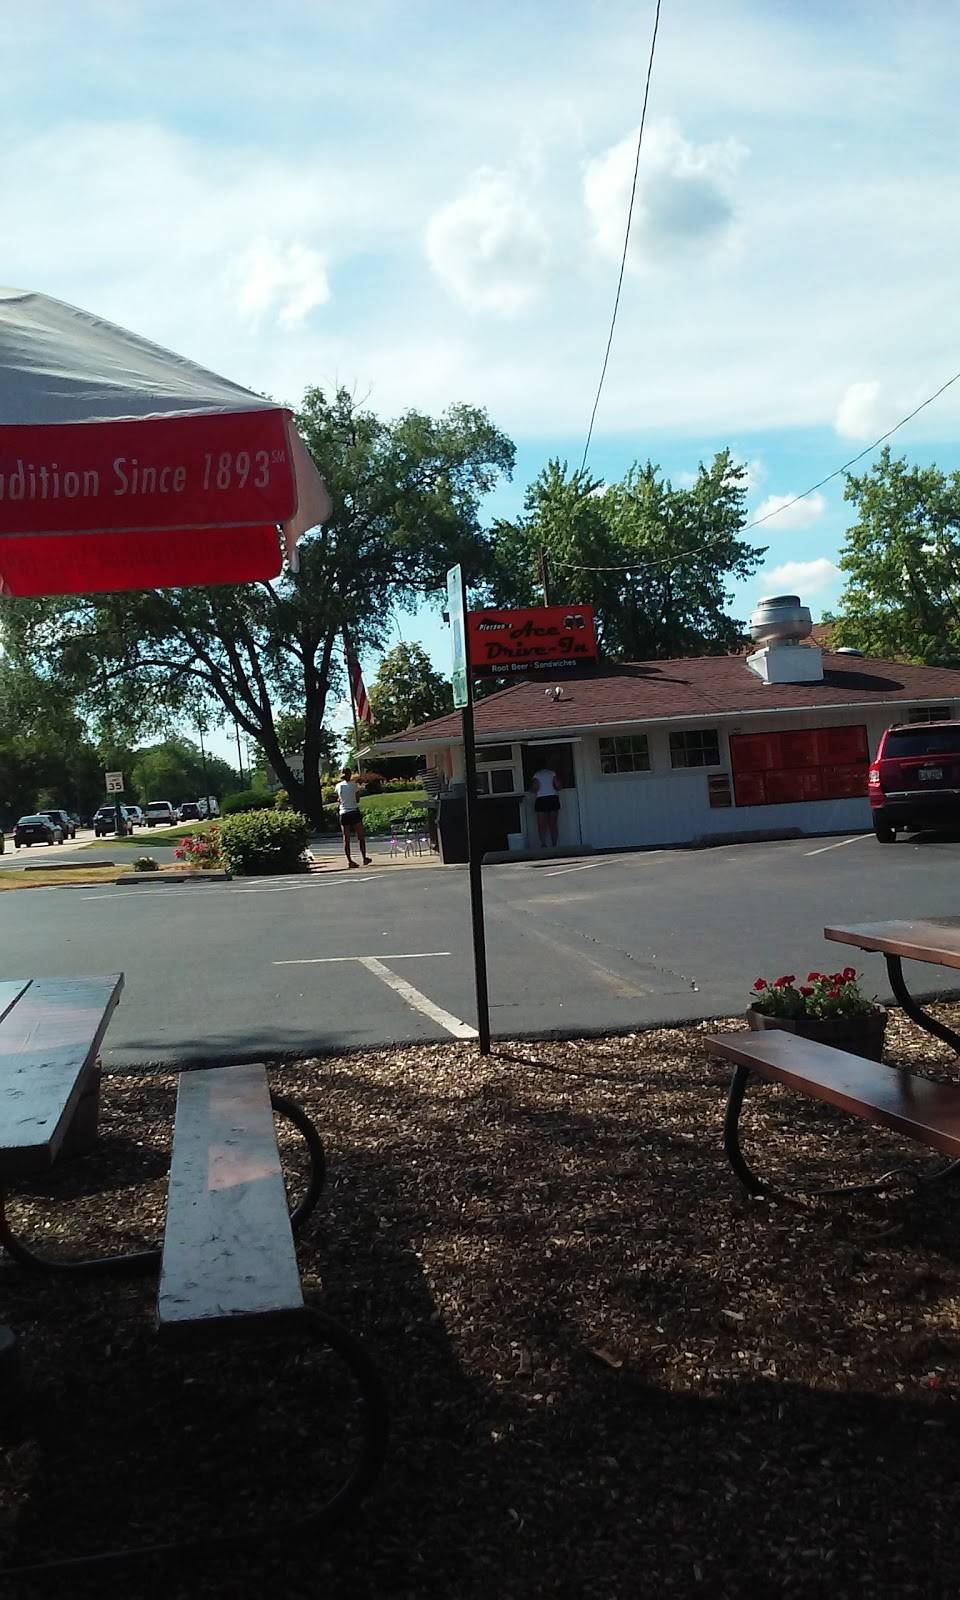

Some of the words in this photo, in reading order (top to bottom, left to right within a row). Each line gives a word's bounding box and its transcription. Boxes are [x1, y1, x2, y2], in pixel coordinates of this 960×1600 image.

[112, 457, 187, 497] Since
[203, 451, 270, 490] 1893
[510, 619, 560, 639] Ace
[484, 636, 588, 659] Drive-In
[534, 659, 577, 669] Sandwiches
